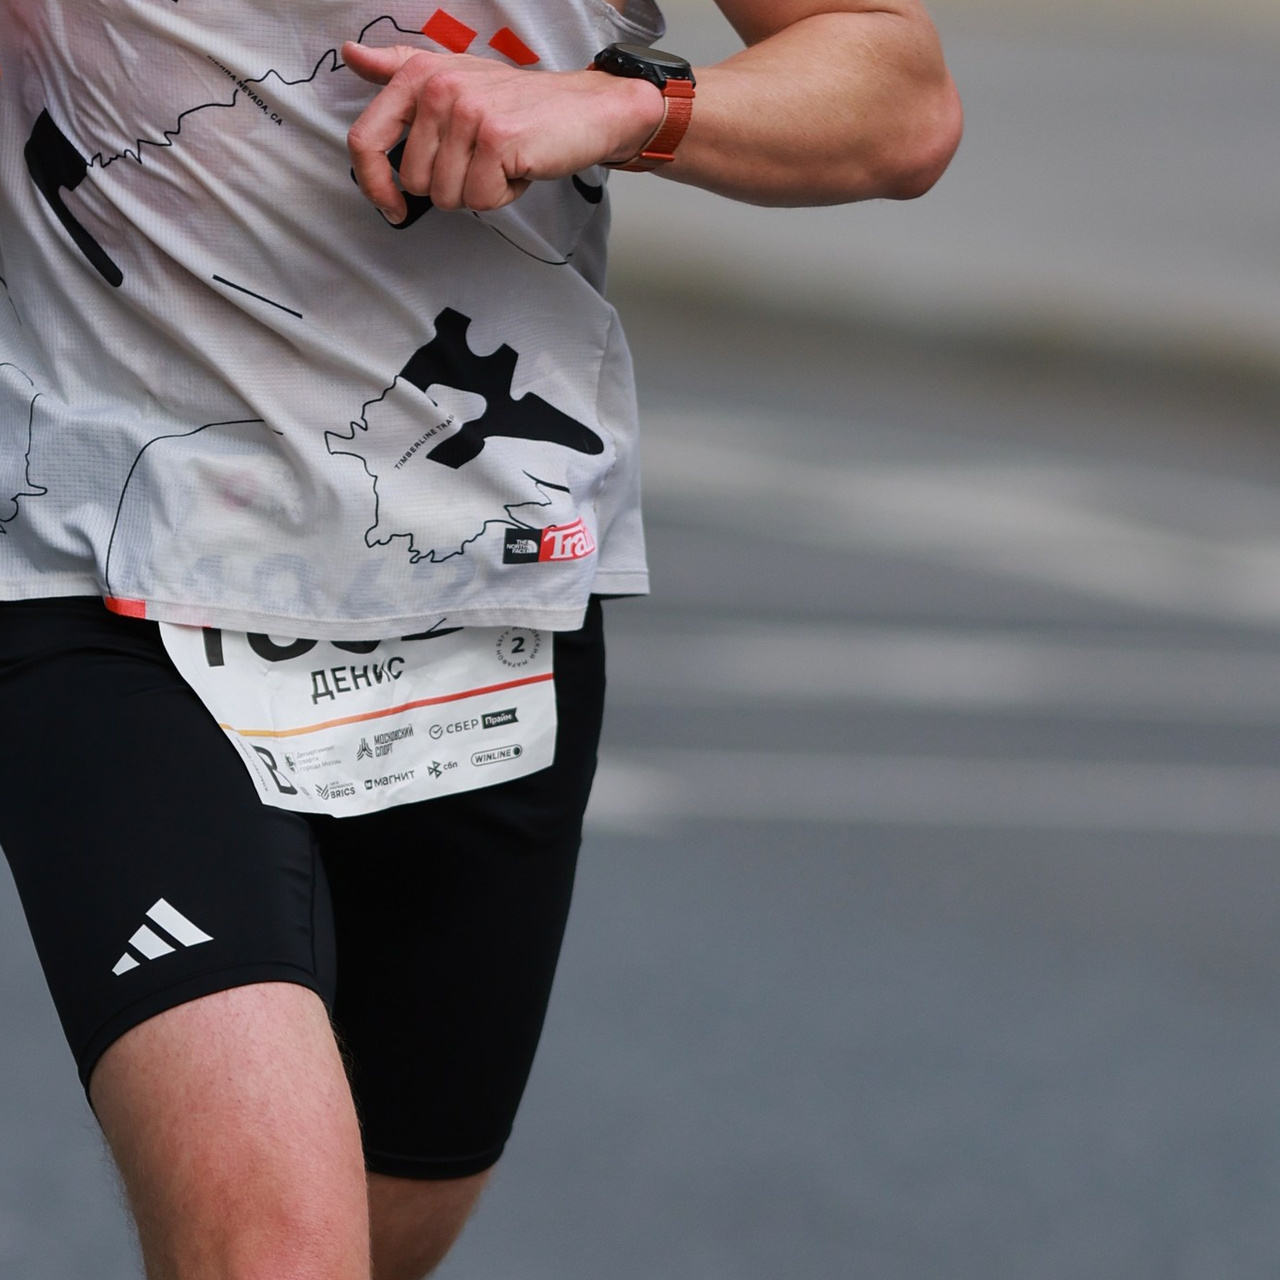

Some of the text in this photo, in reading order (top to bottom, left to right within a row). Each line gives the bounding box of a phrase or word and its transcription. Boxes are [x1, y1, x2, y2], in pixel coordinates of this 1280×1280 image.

[237, 80, 268, 115] NEVADA,
[270, 113, 283, 126] CA
[394, 428, 437, 470] TIMBERLINE
[511, 636, 525, 654] 2
[310, 656, 406, 705] ДЕНИС
[373, 723, 414, 745] МОСКОВСКИЙ
[446, 712, 513, 734] СБЕР Прайм
[375, 742, 393, 757] СПОРТ
[475, 749, 511, 764] WINLINE
[330, 786, 356, 799] BRICS
